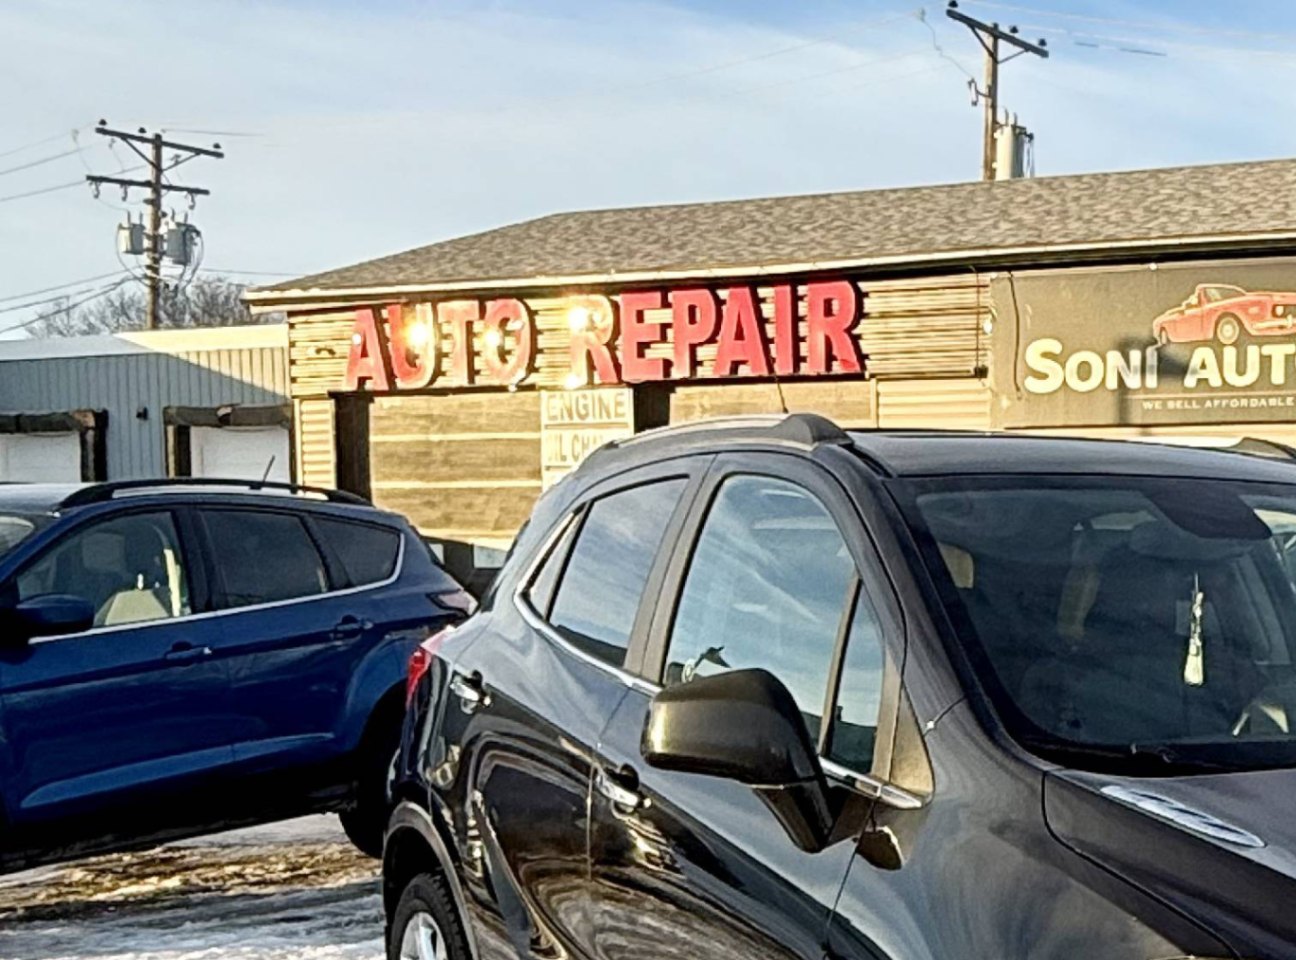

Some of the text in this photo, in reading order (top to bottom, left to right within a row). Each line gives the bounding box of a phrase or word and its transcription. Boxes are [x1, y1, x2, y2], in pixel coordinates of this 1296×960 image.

[343, 281, 860, 391] AUTO REPAIR
[547, 392, 625, 421] ENGINE
[1142, 400, 1164, 410] WE
[1167, 400, 1200, 410] SELL
[1204, 396, 1294, 409] AFFORDABLE
